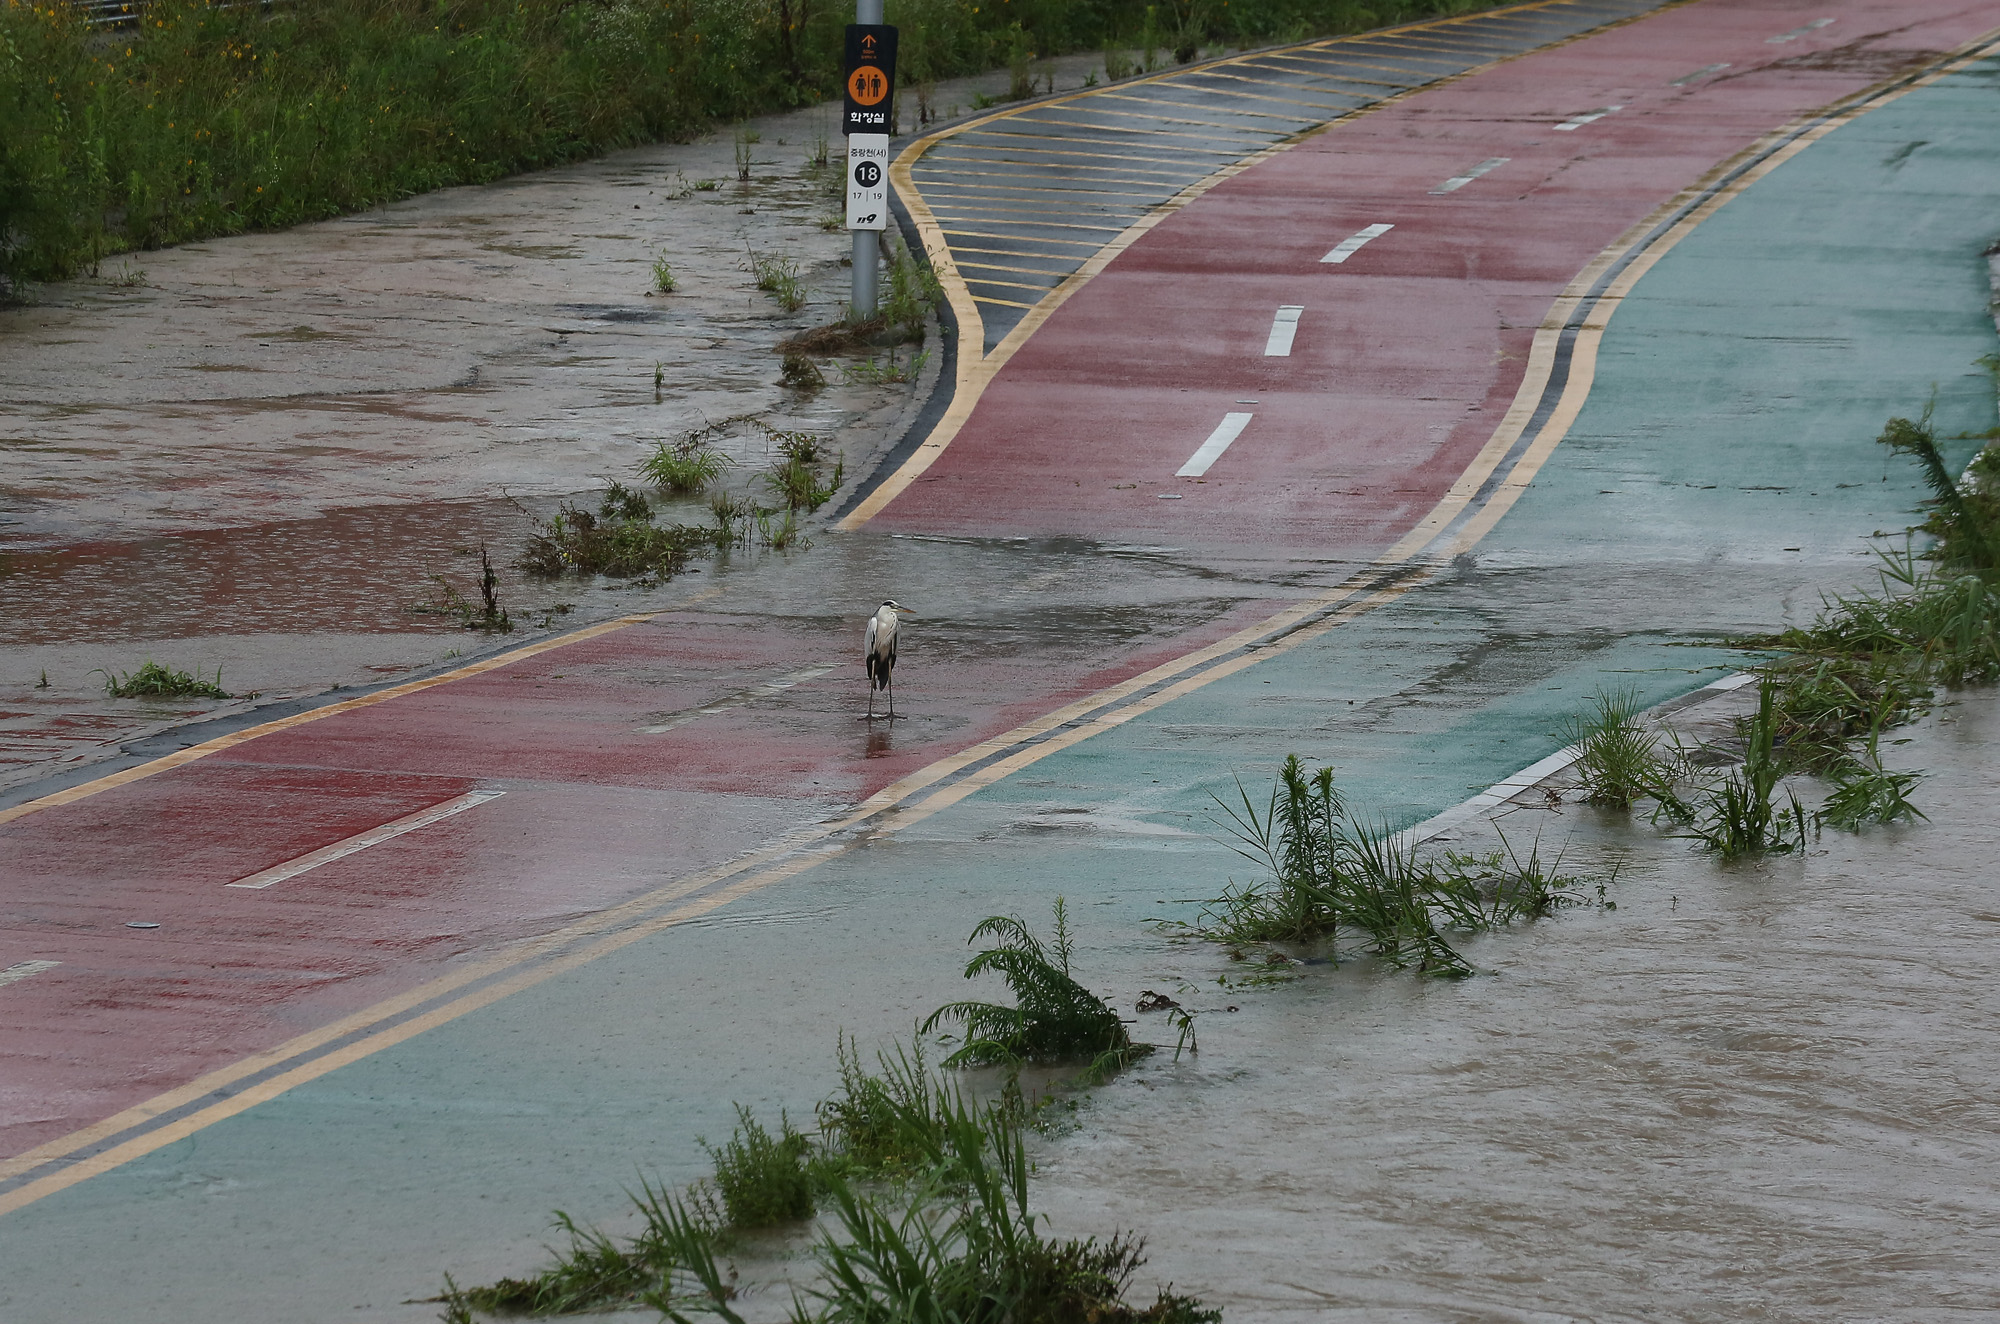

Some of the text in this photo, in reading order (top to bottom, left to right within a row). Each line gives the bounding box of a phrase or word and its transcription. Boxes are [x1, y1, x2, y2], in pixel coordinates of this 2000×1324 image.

[850, 111, 885, 124] 화장실
[851, 148, 887, 158] 중랑천(서)
[859, 167, 878, 181] 18
[873, 192, 882, 200] 19
[856, 213, 877, 224] 119
